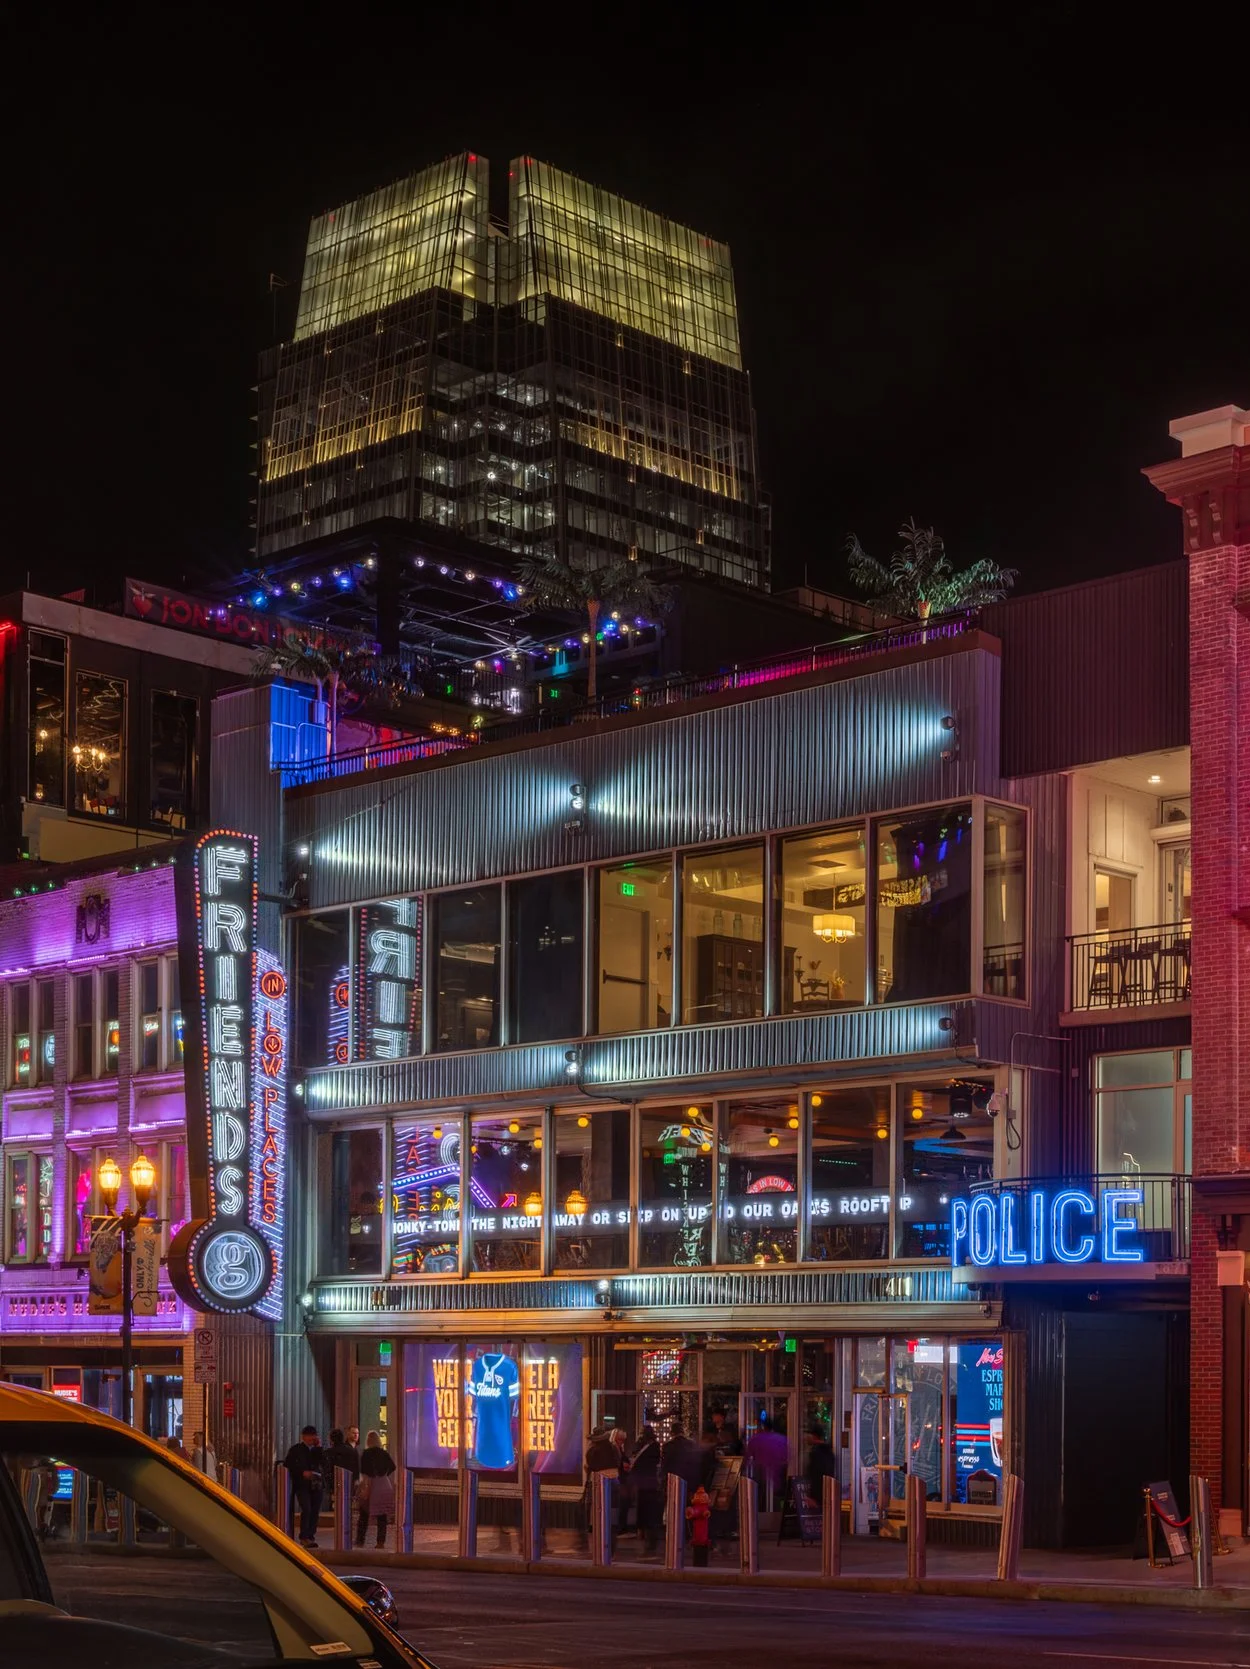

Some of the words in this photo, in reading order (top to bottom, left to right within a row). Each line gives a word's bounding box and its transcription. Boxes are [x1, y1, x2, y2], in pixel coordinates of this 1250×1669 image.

[267, 978, 279, 994] IN
[203, 845, 248, 1216] FRIENDS
[261, 1087, 279, 1224] PLACES
[471, 1217, 495, 1231] THE
[502, 1215, 542, 1231] NIGHT
[592, 1211, 610, 1226] OR
[661, 1208, 679, 1221] ON
[688, 1206, 707, 1220] UP
[743, 1203, 773, 1218] OUR
[840, 1196, 912, 1213] ROOFTP
[952, 1189, 1144, 1267] POLICE
[136, 1265, 145, 1289] ONLY
[476, 1382, 502, 1398] Titans
